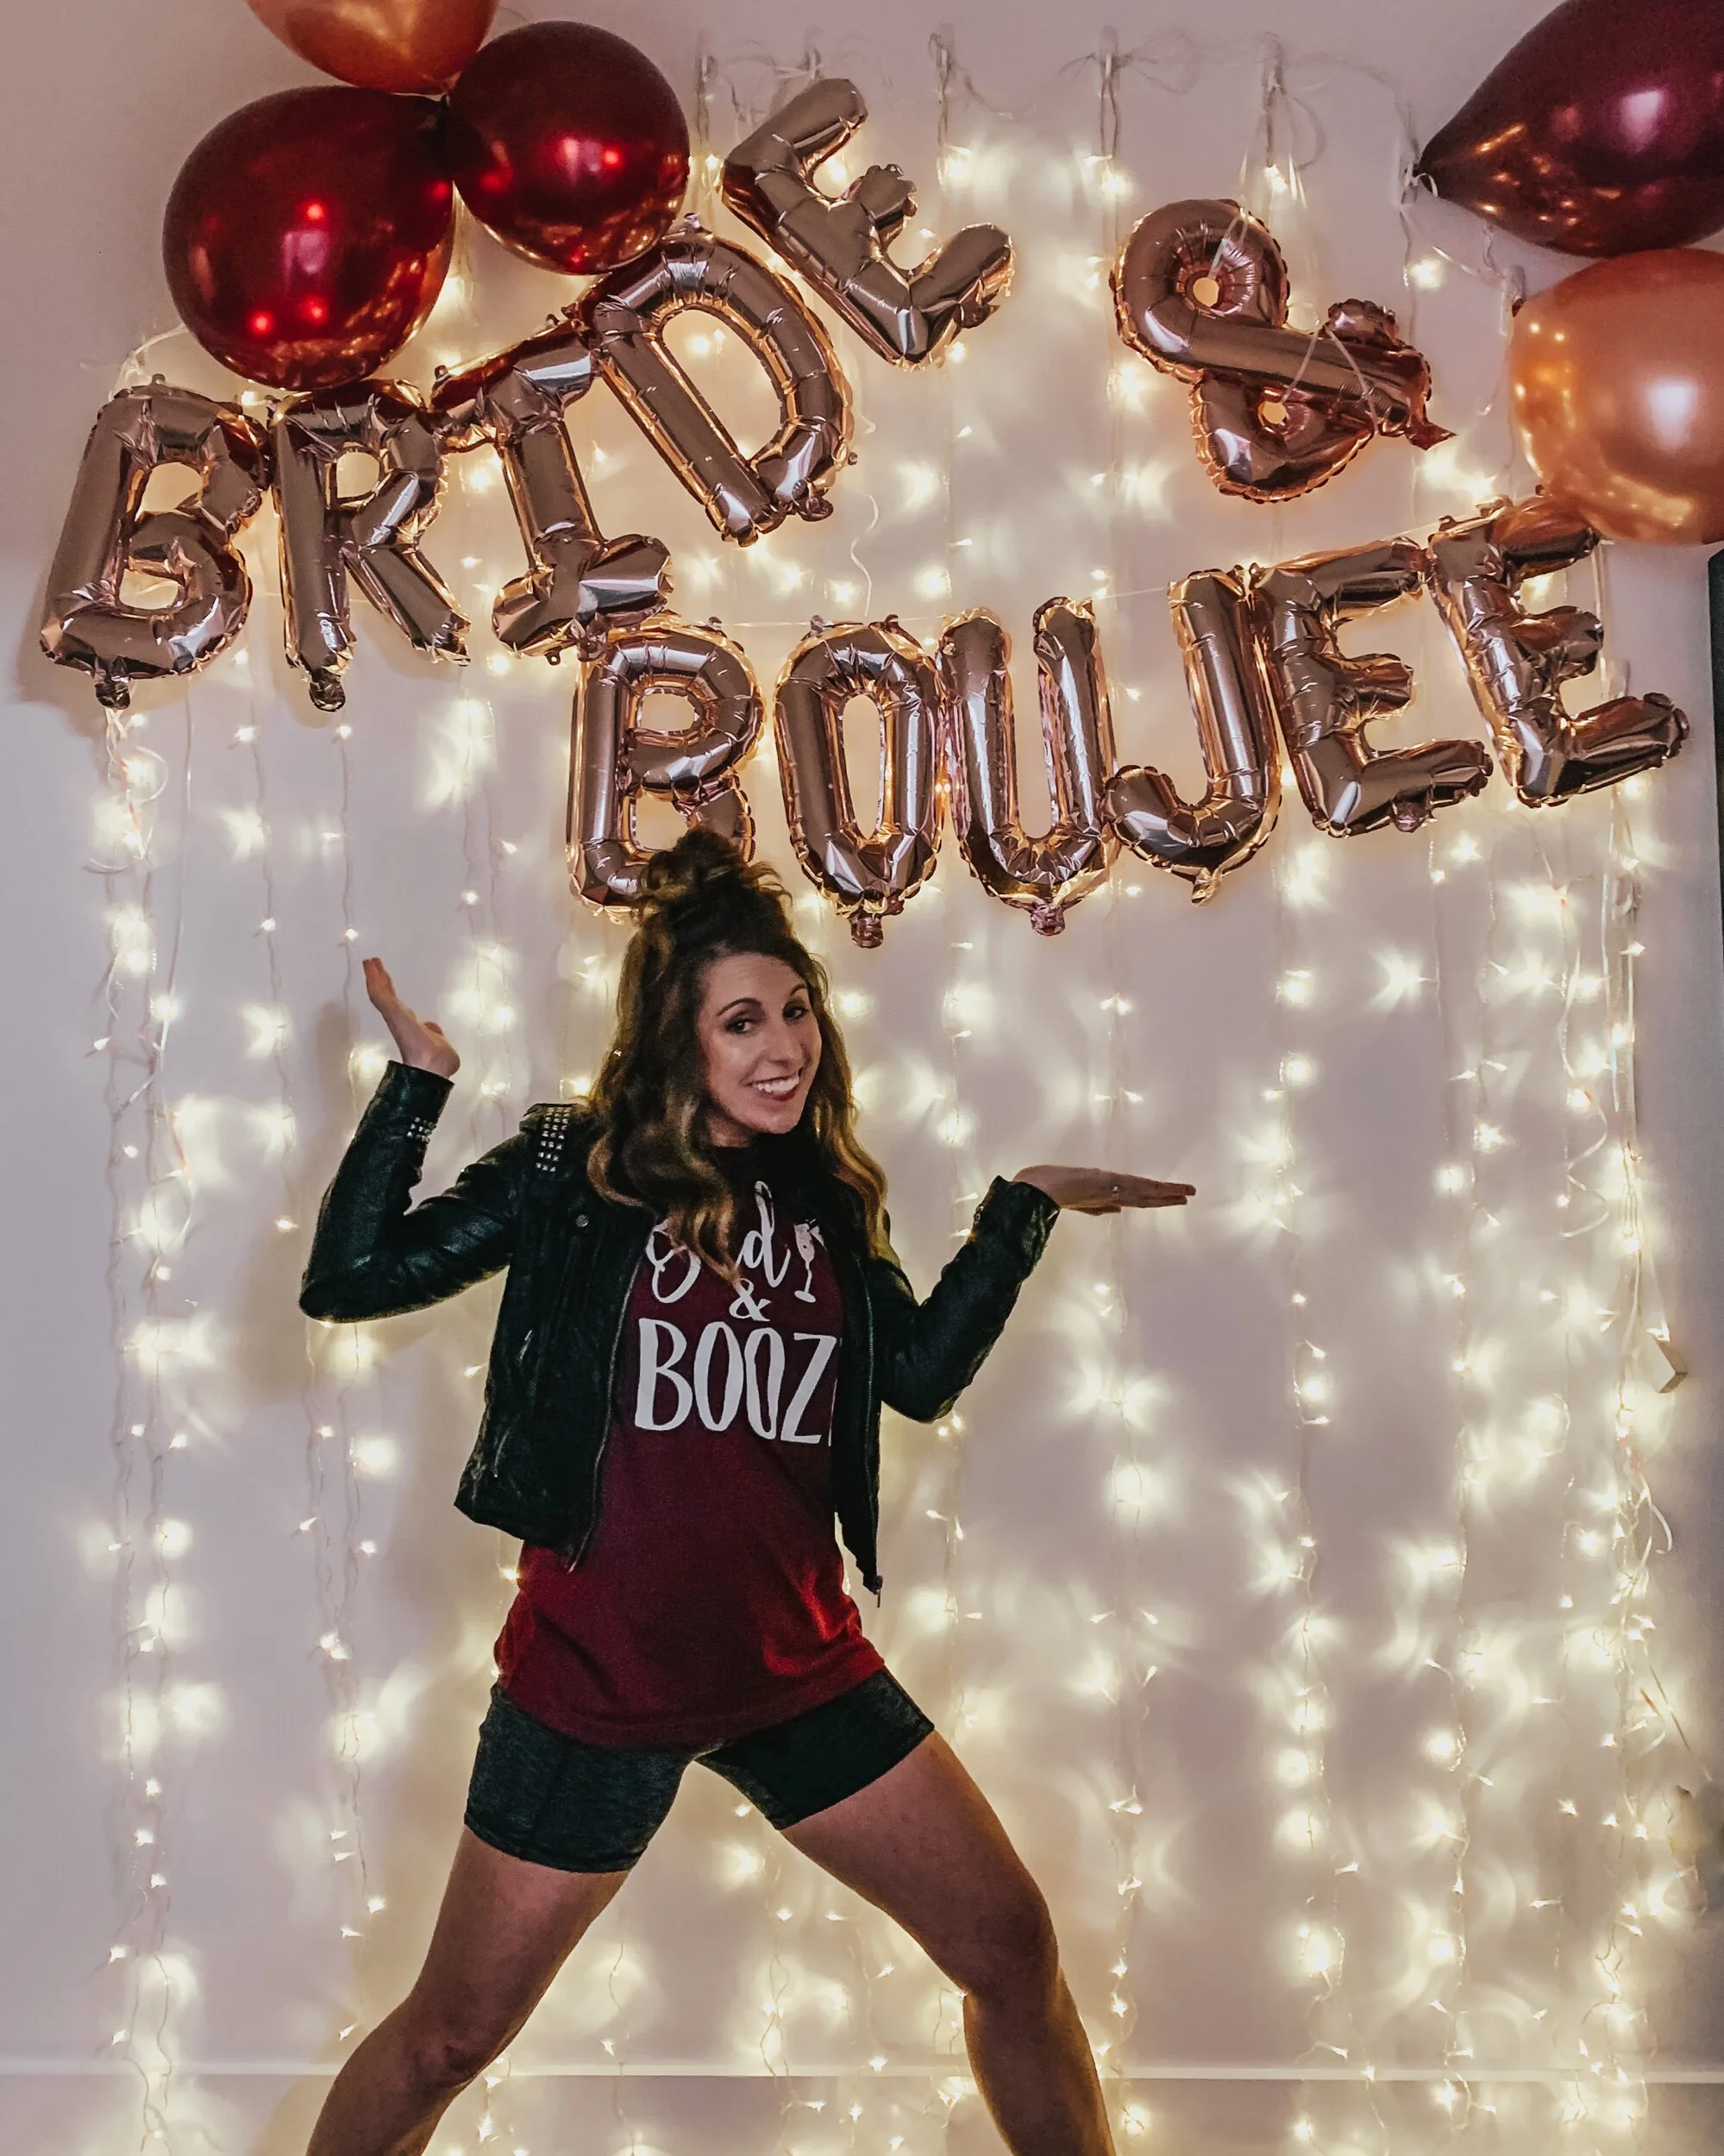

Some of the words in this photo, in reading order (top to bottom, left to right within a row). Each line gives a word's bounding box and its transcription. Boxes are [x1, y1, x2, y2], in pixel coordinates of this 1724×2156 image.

[39, 78, 1016, 711] BRIDE
[1108, 197, 1458, 505] &
[565, 487, 1690, 948] BOUJEE
[634, 1317, 842, 1446] BOOZ
[729, 1277, 771, 1322] &
